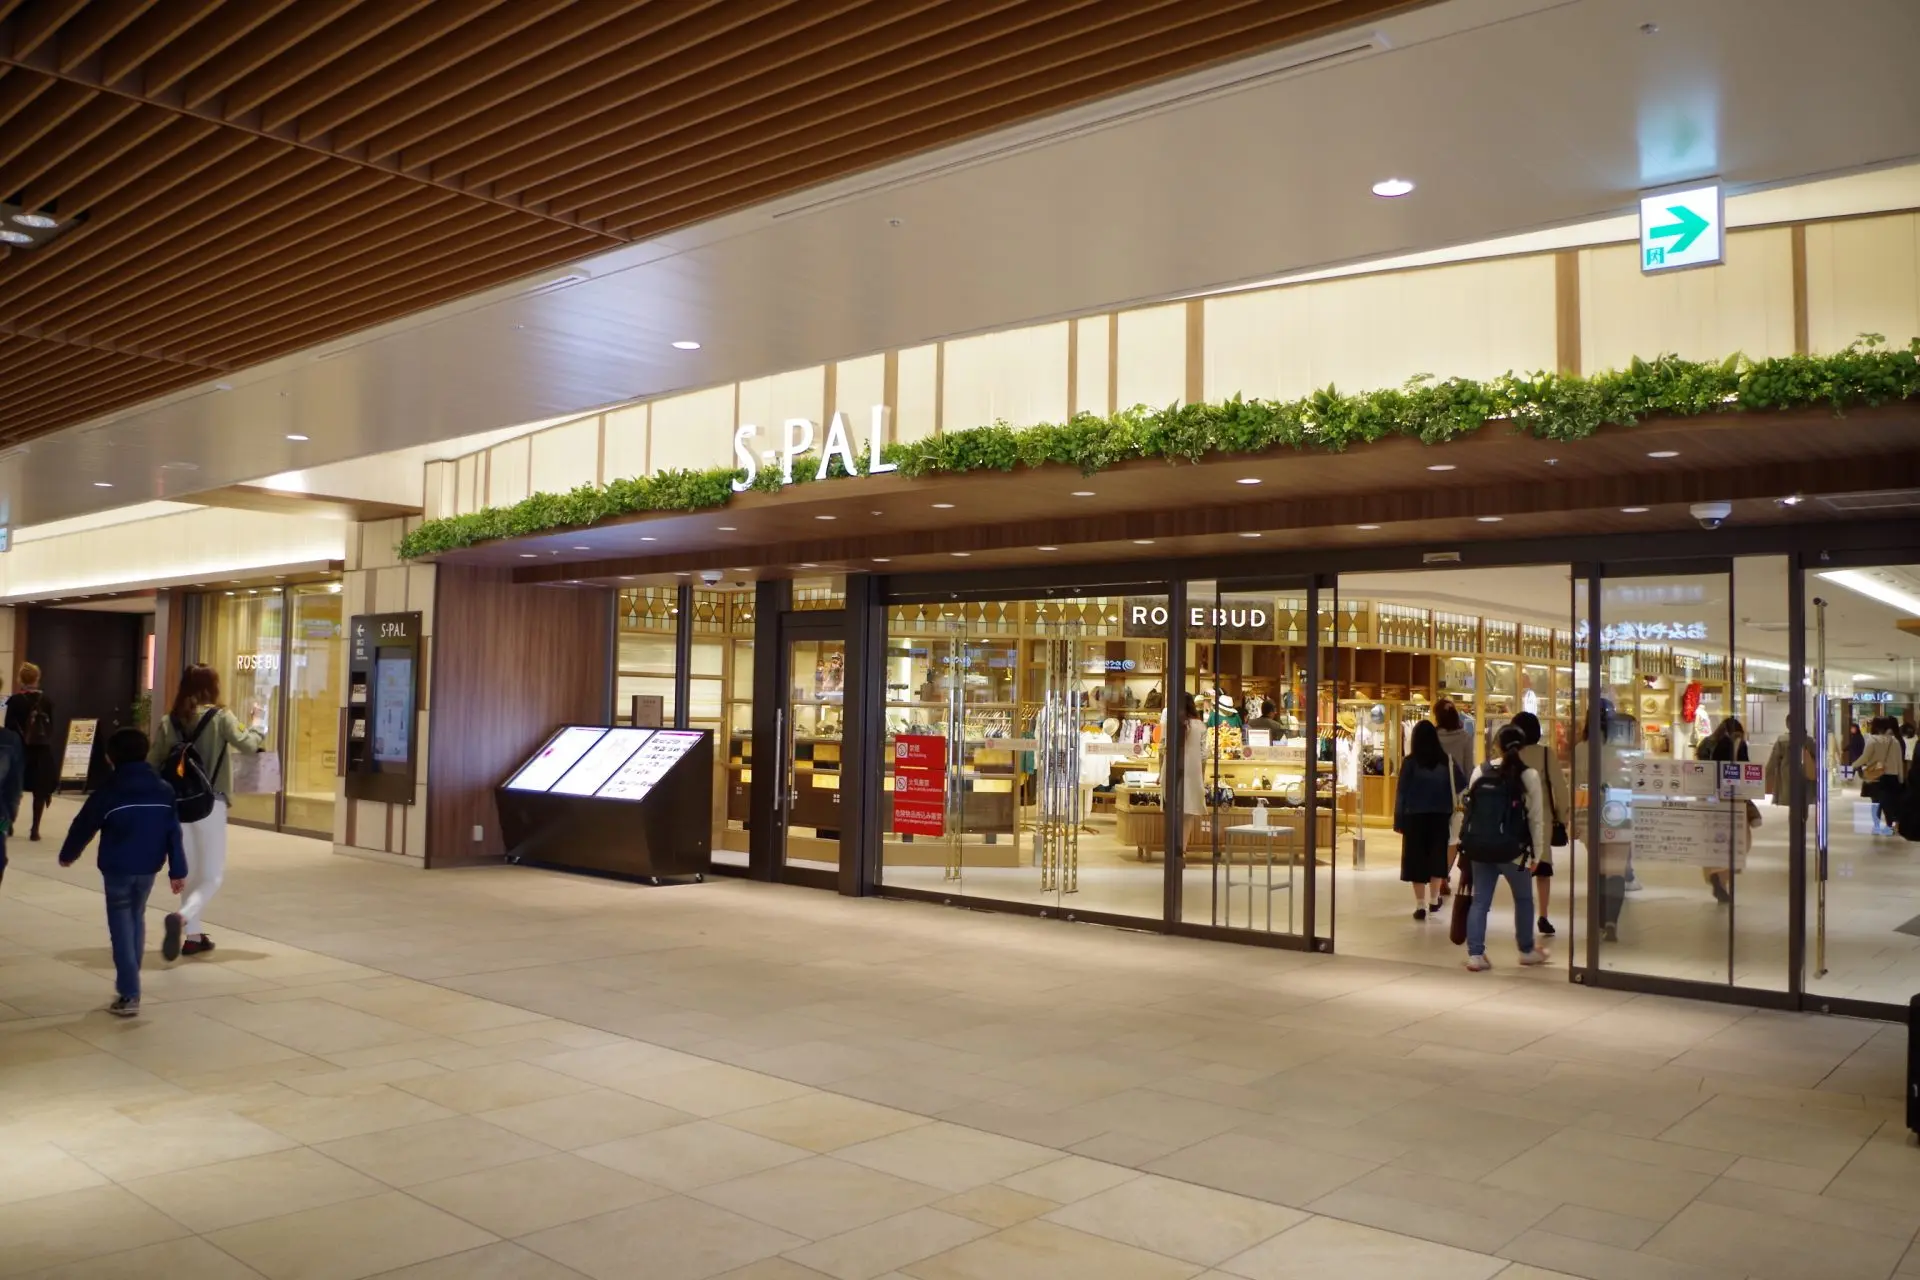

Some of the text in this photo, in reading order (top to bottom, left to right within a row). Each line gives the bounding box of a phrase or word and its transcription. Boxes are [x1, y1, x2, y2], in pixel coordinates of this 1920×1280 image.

[732, 404, 898, 492] S-PAL
[1132, 606, 1266, 628] ROEBUD
[380, 622, 406, 637] S-PAL
[237, 654, 280, 670] ROSEBU
